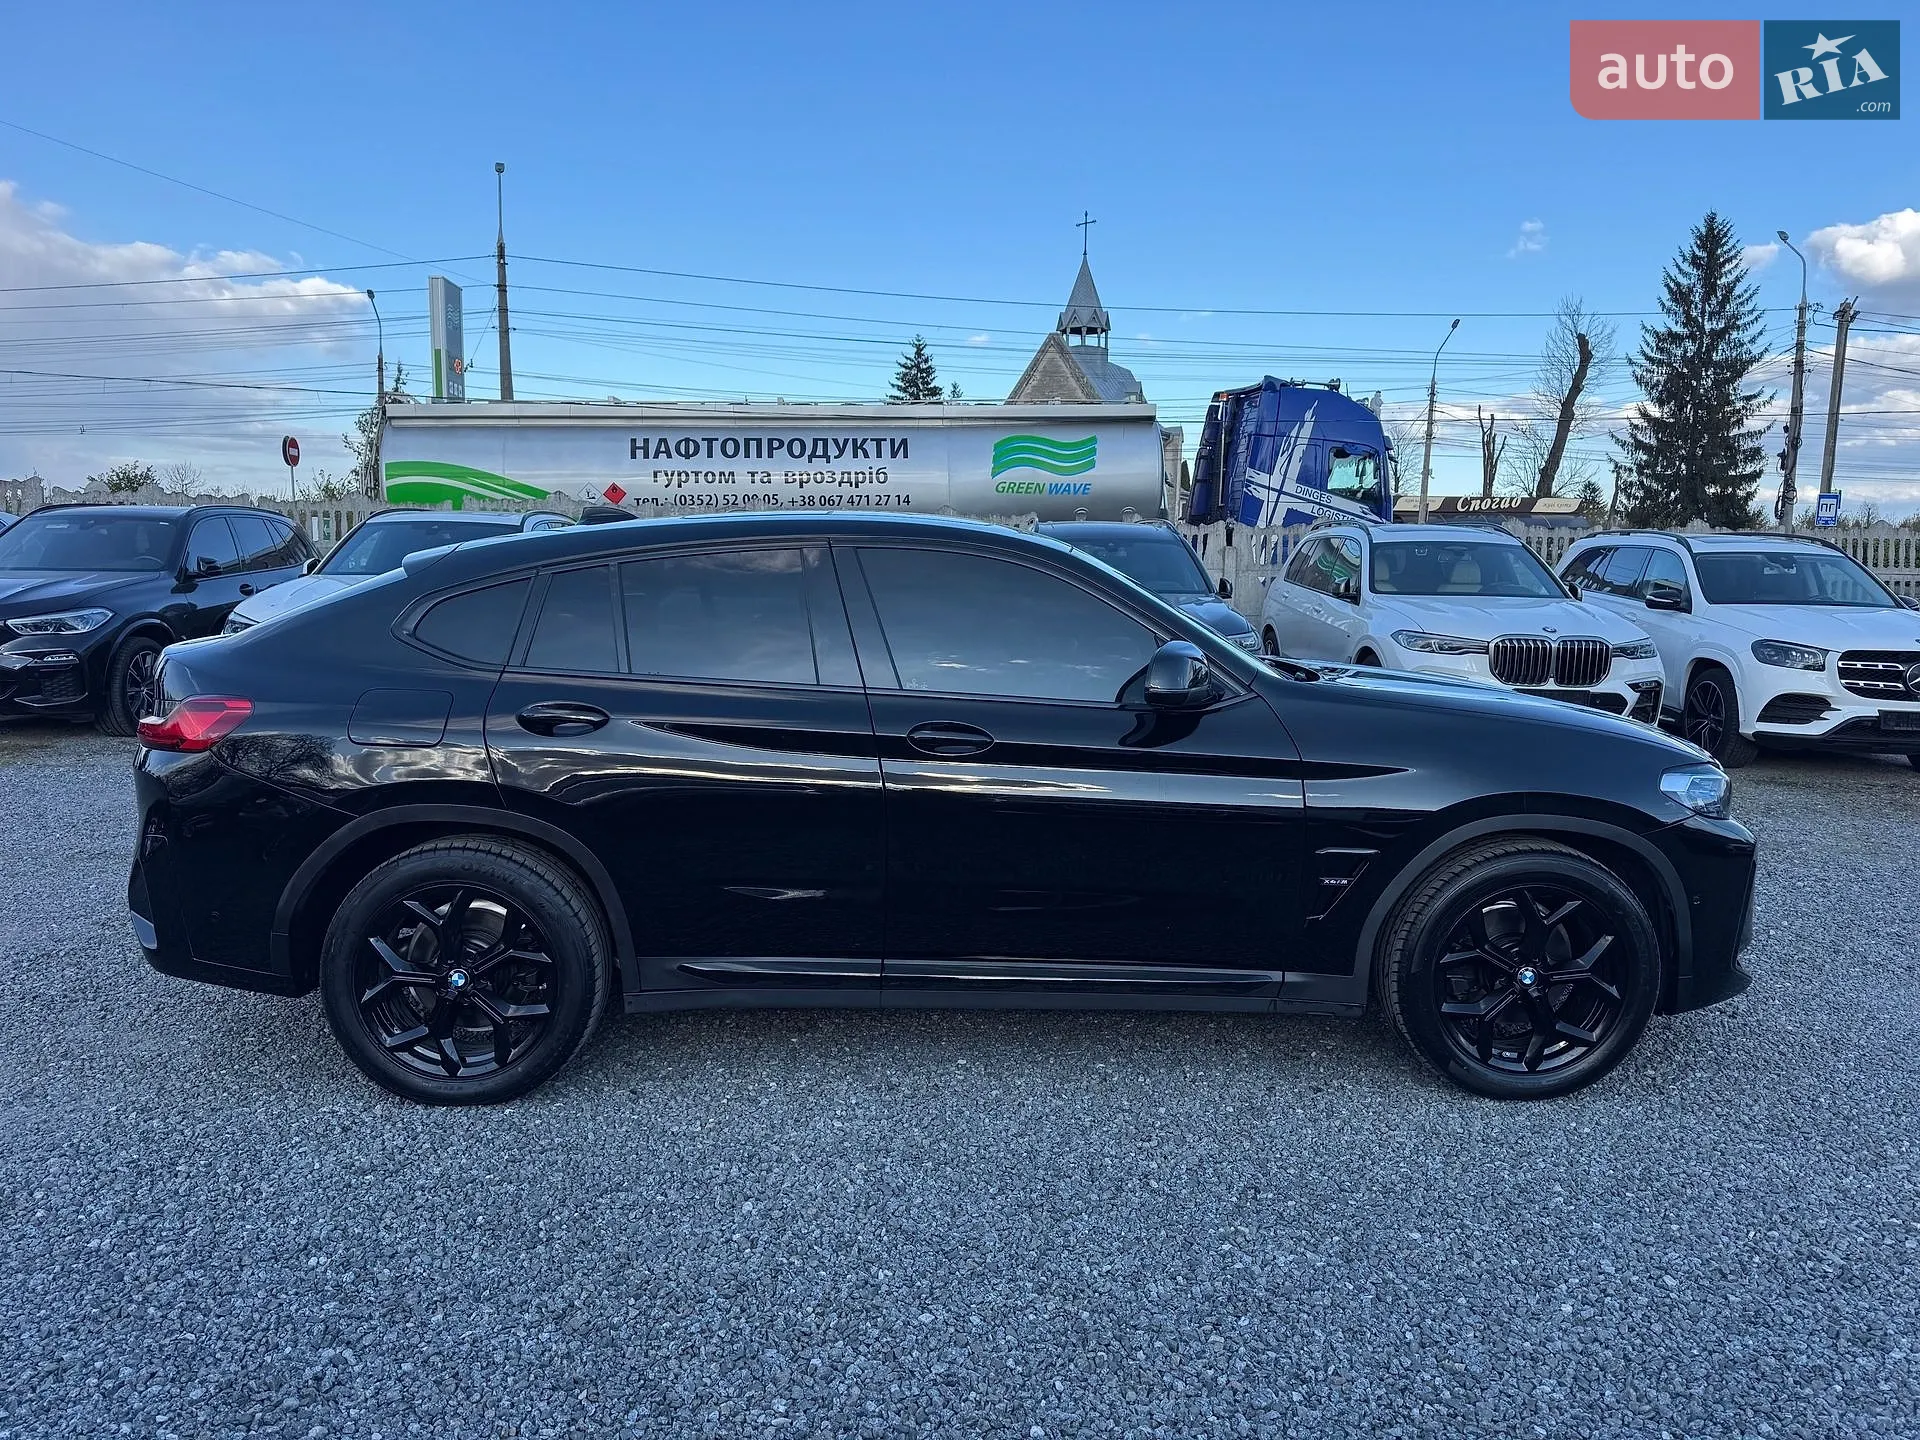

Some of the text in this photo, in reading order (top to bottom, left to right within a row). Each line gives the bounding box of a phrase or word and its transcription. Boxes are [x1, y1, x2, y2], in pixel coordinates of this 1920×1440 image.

[630, 437, 909, 463] НАФТОПРОДУКТИ
[652, 466, 888, 488] гуртом та вроздріб
[995, 481, 1092, 495] GREEN WAVE
[1296, 485, 1333, 504] DINGES
[673, 493, 719, 508] (0352)
[722, 494, 738, 506] 52
[763, 493, 784, 508] 05,
[788, 495, 816, 507] +38
[819, 495, 843, 507] 067
[847, 494, 870, 506] 471
[875, 494, 891, 506] 27
[895, 494, 911, 506] 14
